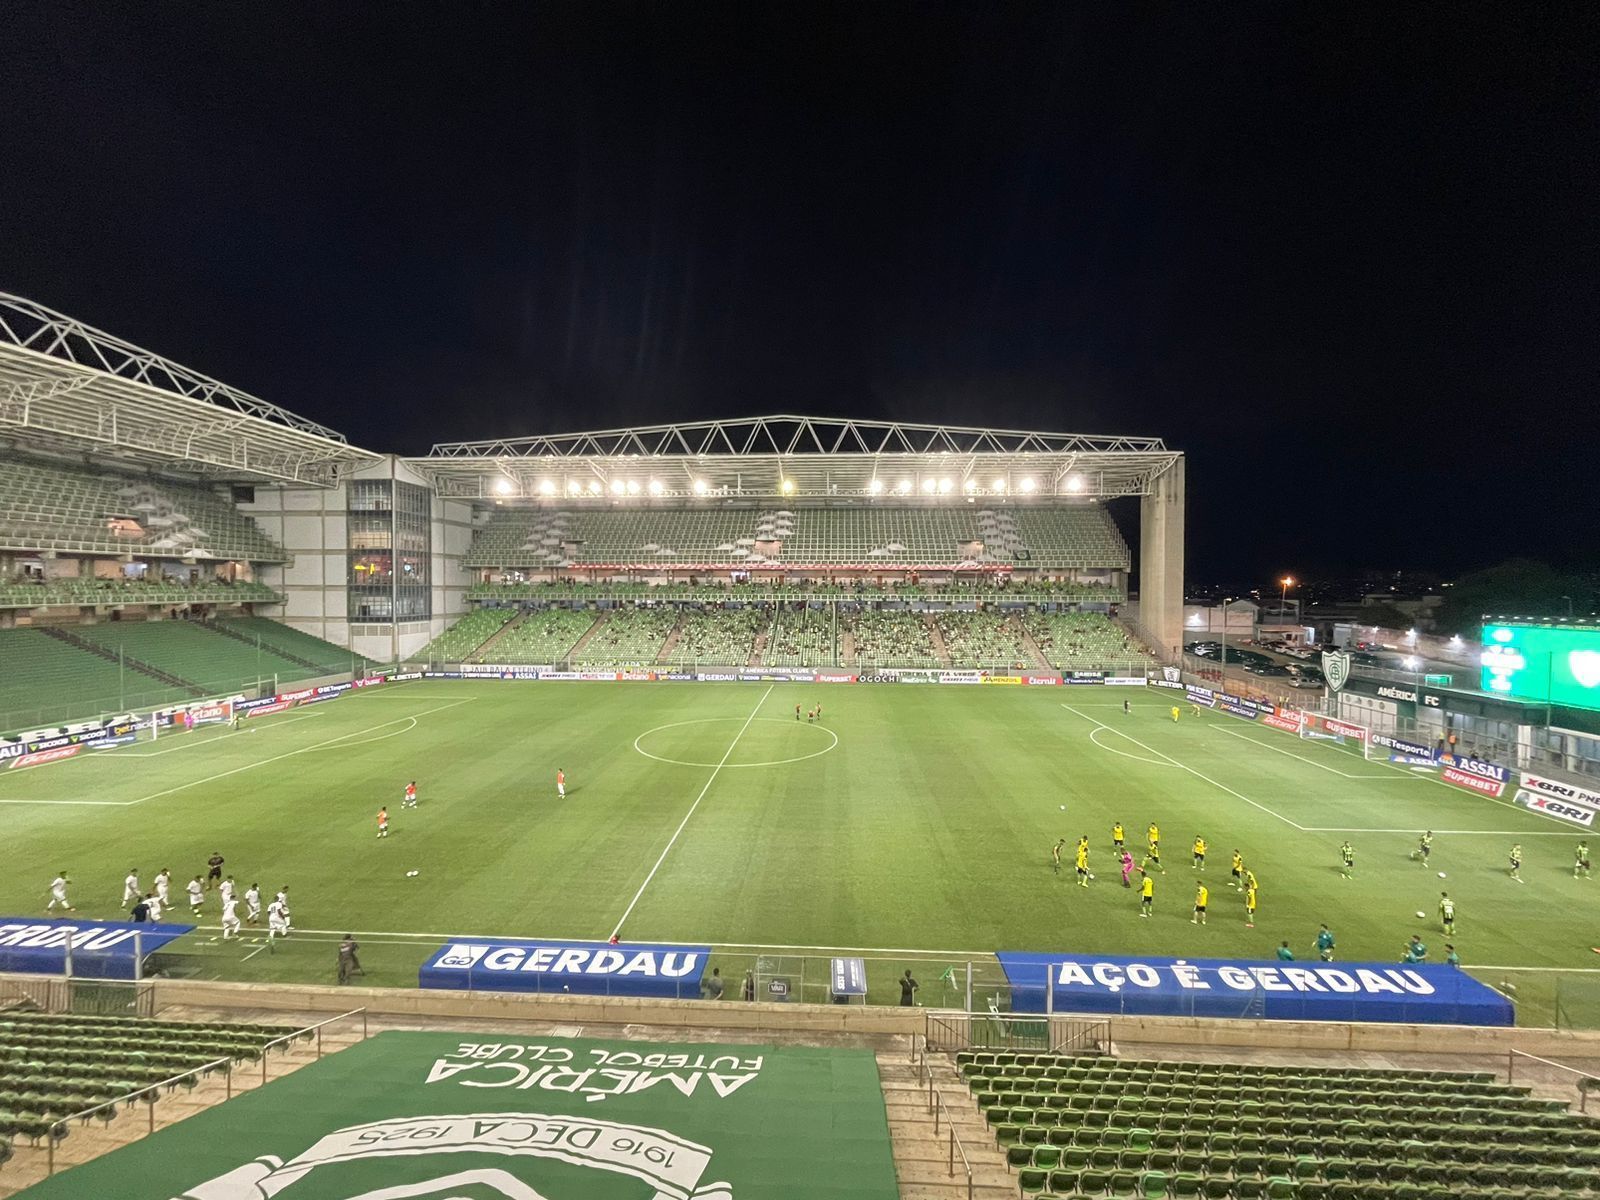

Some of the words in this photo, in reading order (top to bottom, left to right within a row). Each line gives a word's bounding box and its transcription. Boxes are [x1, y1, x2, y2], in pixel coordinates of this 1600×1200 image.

[705, 674, 733, 682] GERDAU
[281, 688, 314, 701] SUPERBET
[1377, 686, 1416, 702] AMÉRICA
[1424, 695, 1439, 706] FC
[1325, 721, 1366, 740] SUPERBET
[1380, 736, 1431, 758] BETesporte
[1443, 769, 1499, 792] SUPERBET
[1525, 775, 1575, 797] XBRI
[1532, 796, 1590, 822] XBRI
[482, 948, 698, 977] GERDAU
[1058, 961, 1161, 992] AÇO
[1172, 960, 1211, 989] É
[1218, 966, 1437, 995] GERDAU
[455, 1043, 574, 1062] CLUBE
[590, 1049, 764, 1071] FUTEBOL
[425, 1058, 759, 1102] AMÉRICA
[350, 1125, 453, 1147] 1925
[472, 1120, 602, 1150] DECA
[610, 1137, 676, 1169] 1916
